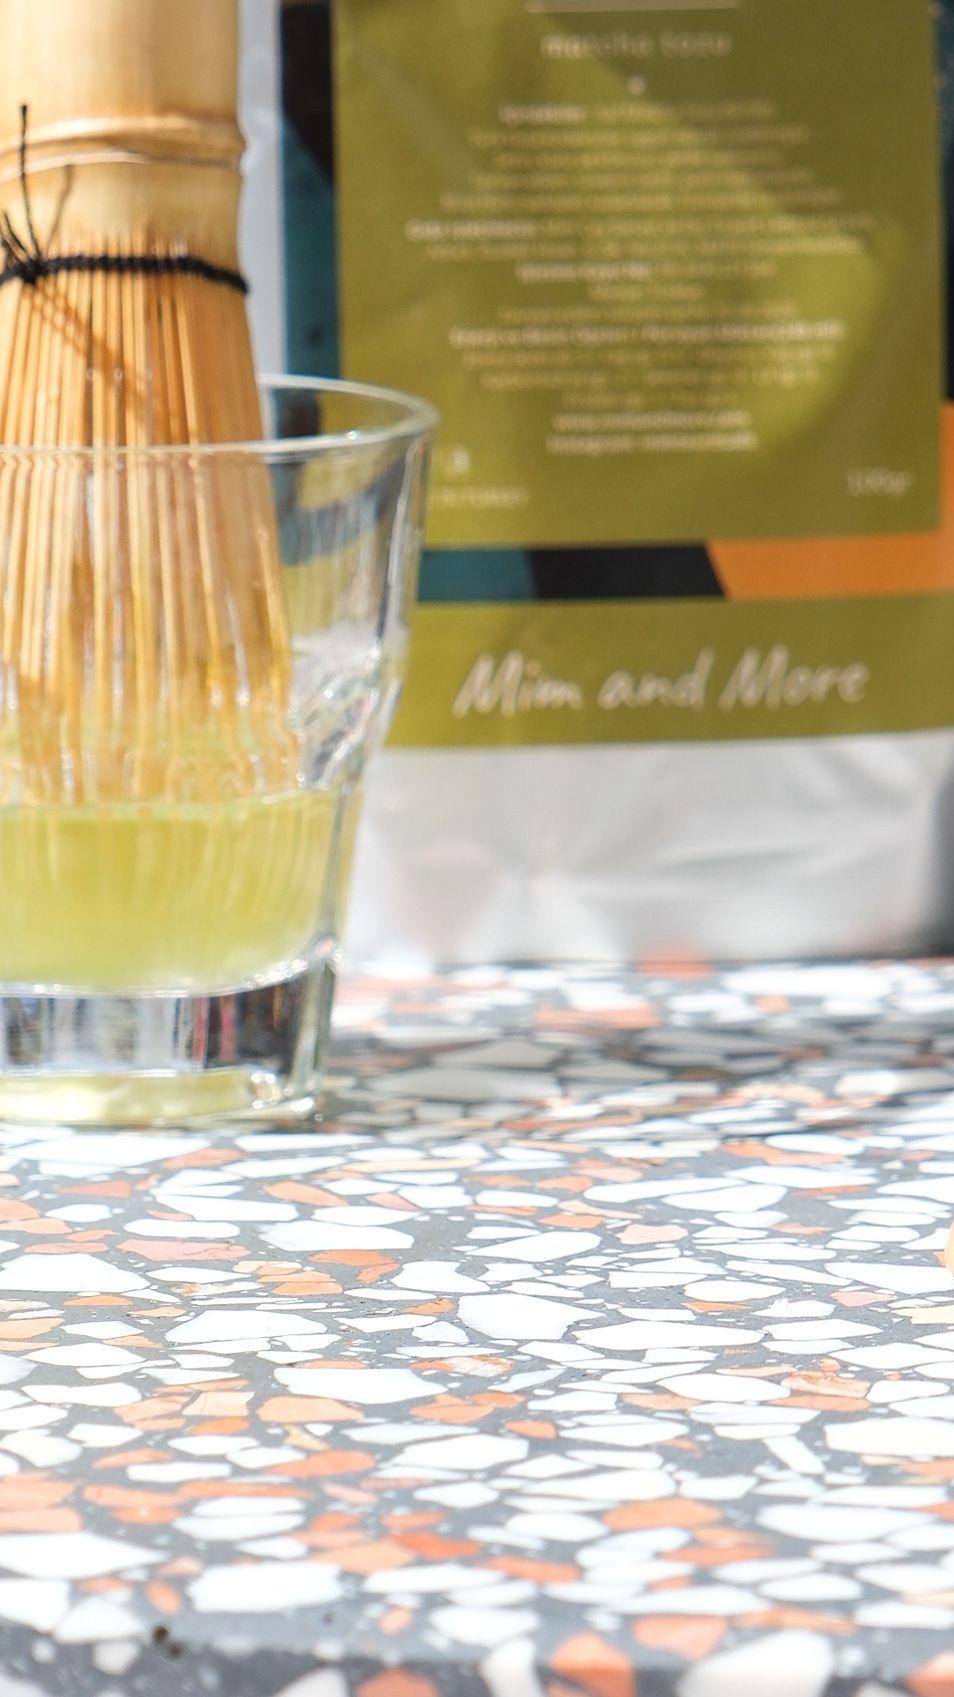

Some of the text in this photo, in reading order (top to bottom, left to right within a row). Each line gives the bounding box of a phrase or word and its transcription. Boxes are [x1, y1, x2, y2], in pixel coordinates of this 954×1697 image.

[451, 644, 869, 717] Mim and More
